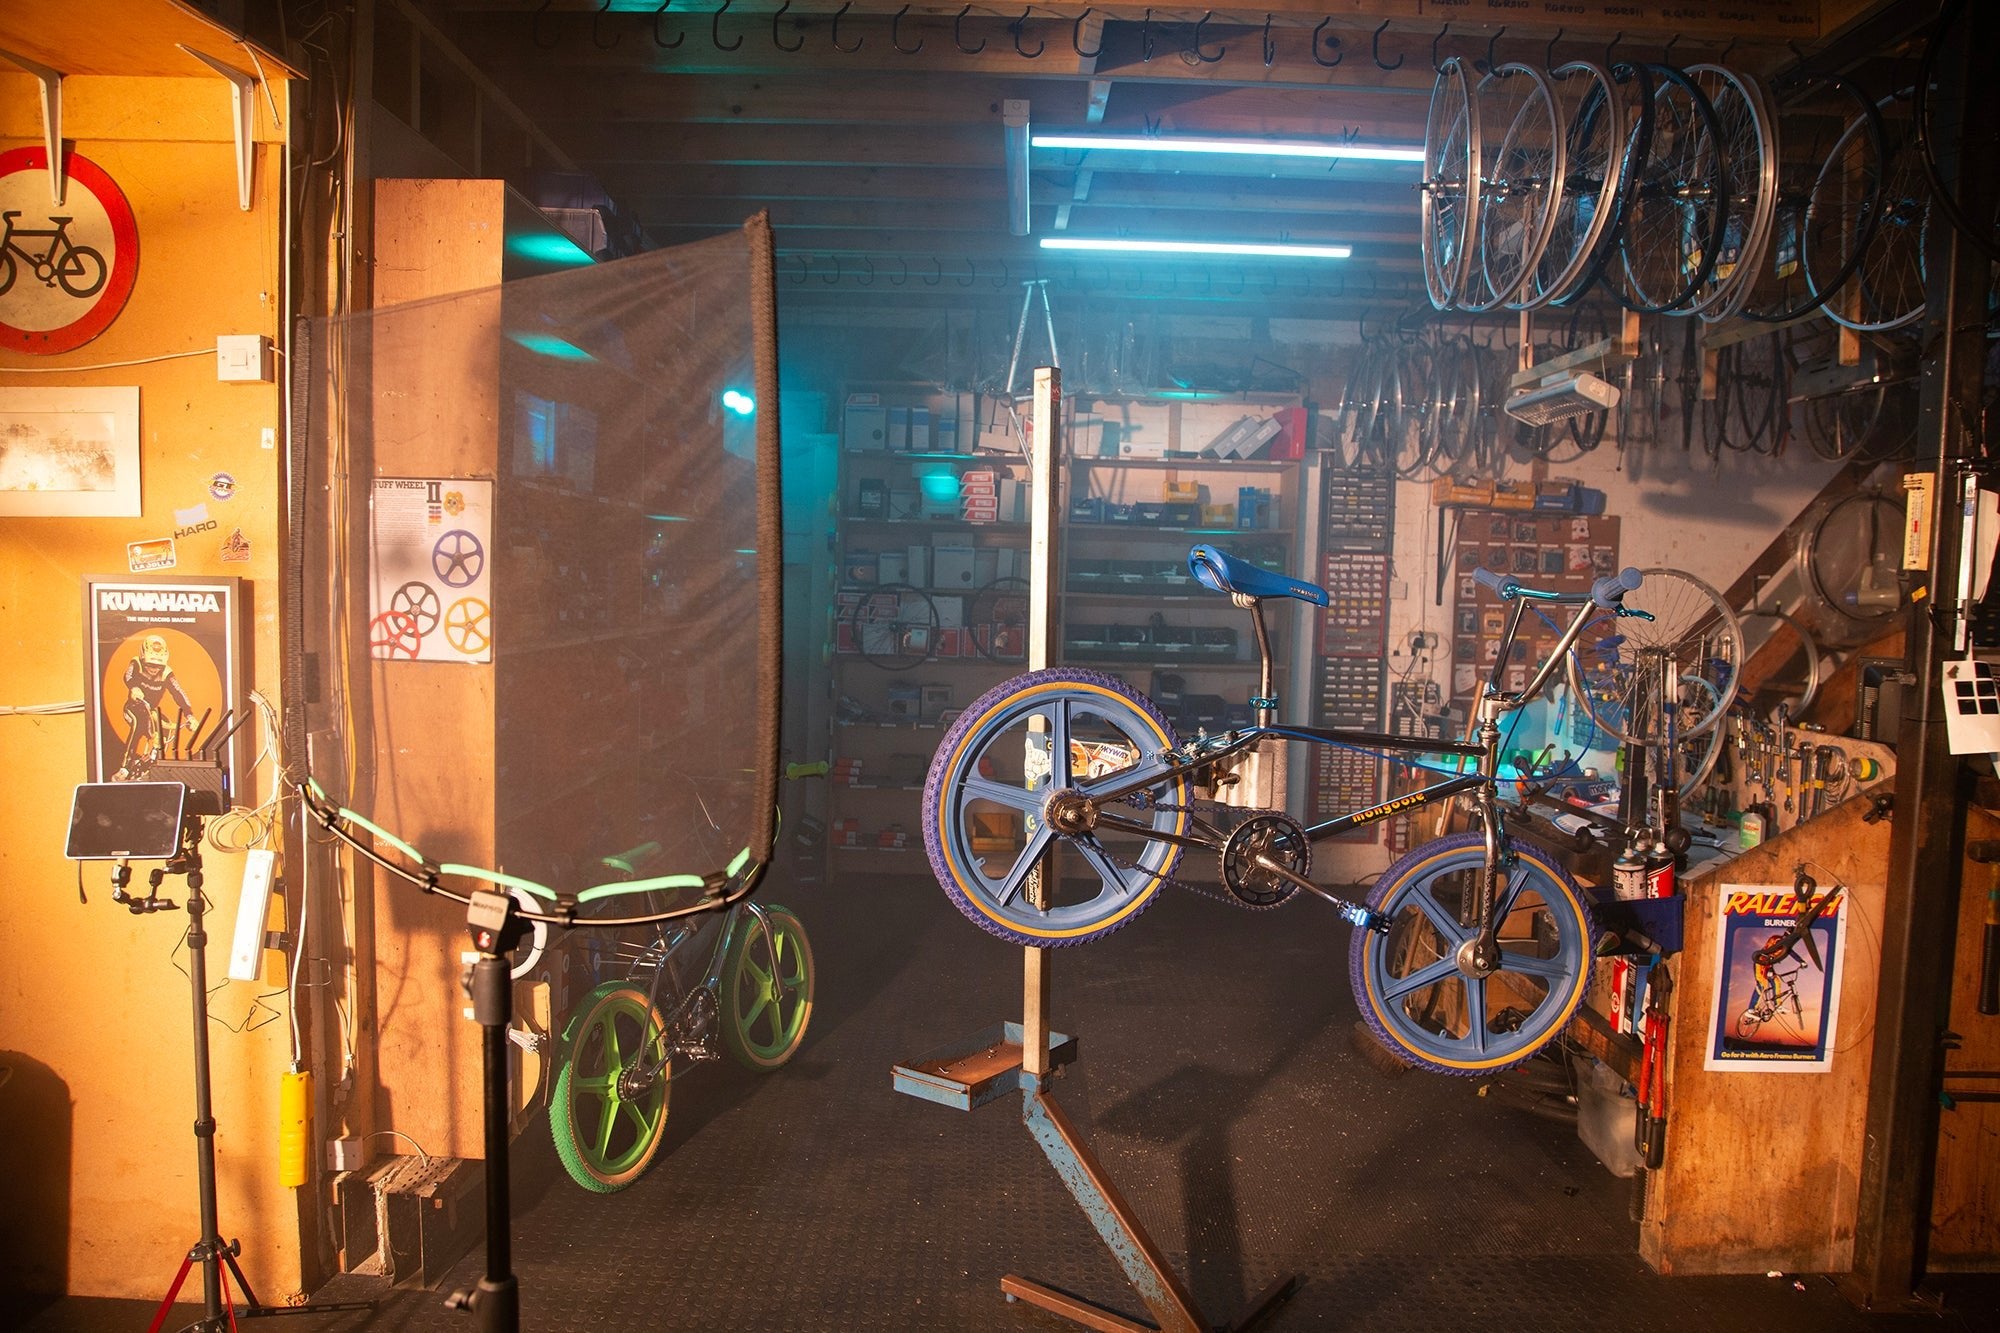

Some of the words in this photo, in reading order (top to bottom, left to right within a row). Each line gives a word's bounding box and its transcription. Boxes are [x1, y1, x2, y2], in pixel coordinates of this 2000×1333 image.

[395, 481, 426, 489] WHEEL
[174, 520, 218, 540] HARO
[100, 591, 220, 612] KUWAHARA
[1352, 793, 1425, 823] mongoose
[1764, 919, 1797, 927] BURNER
